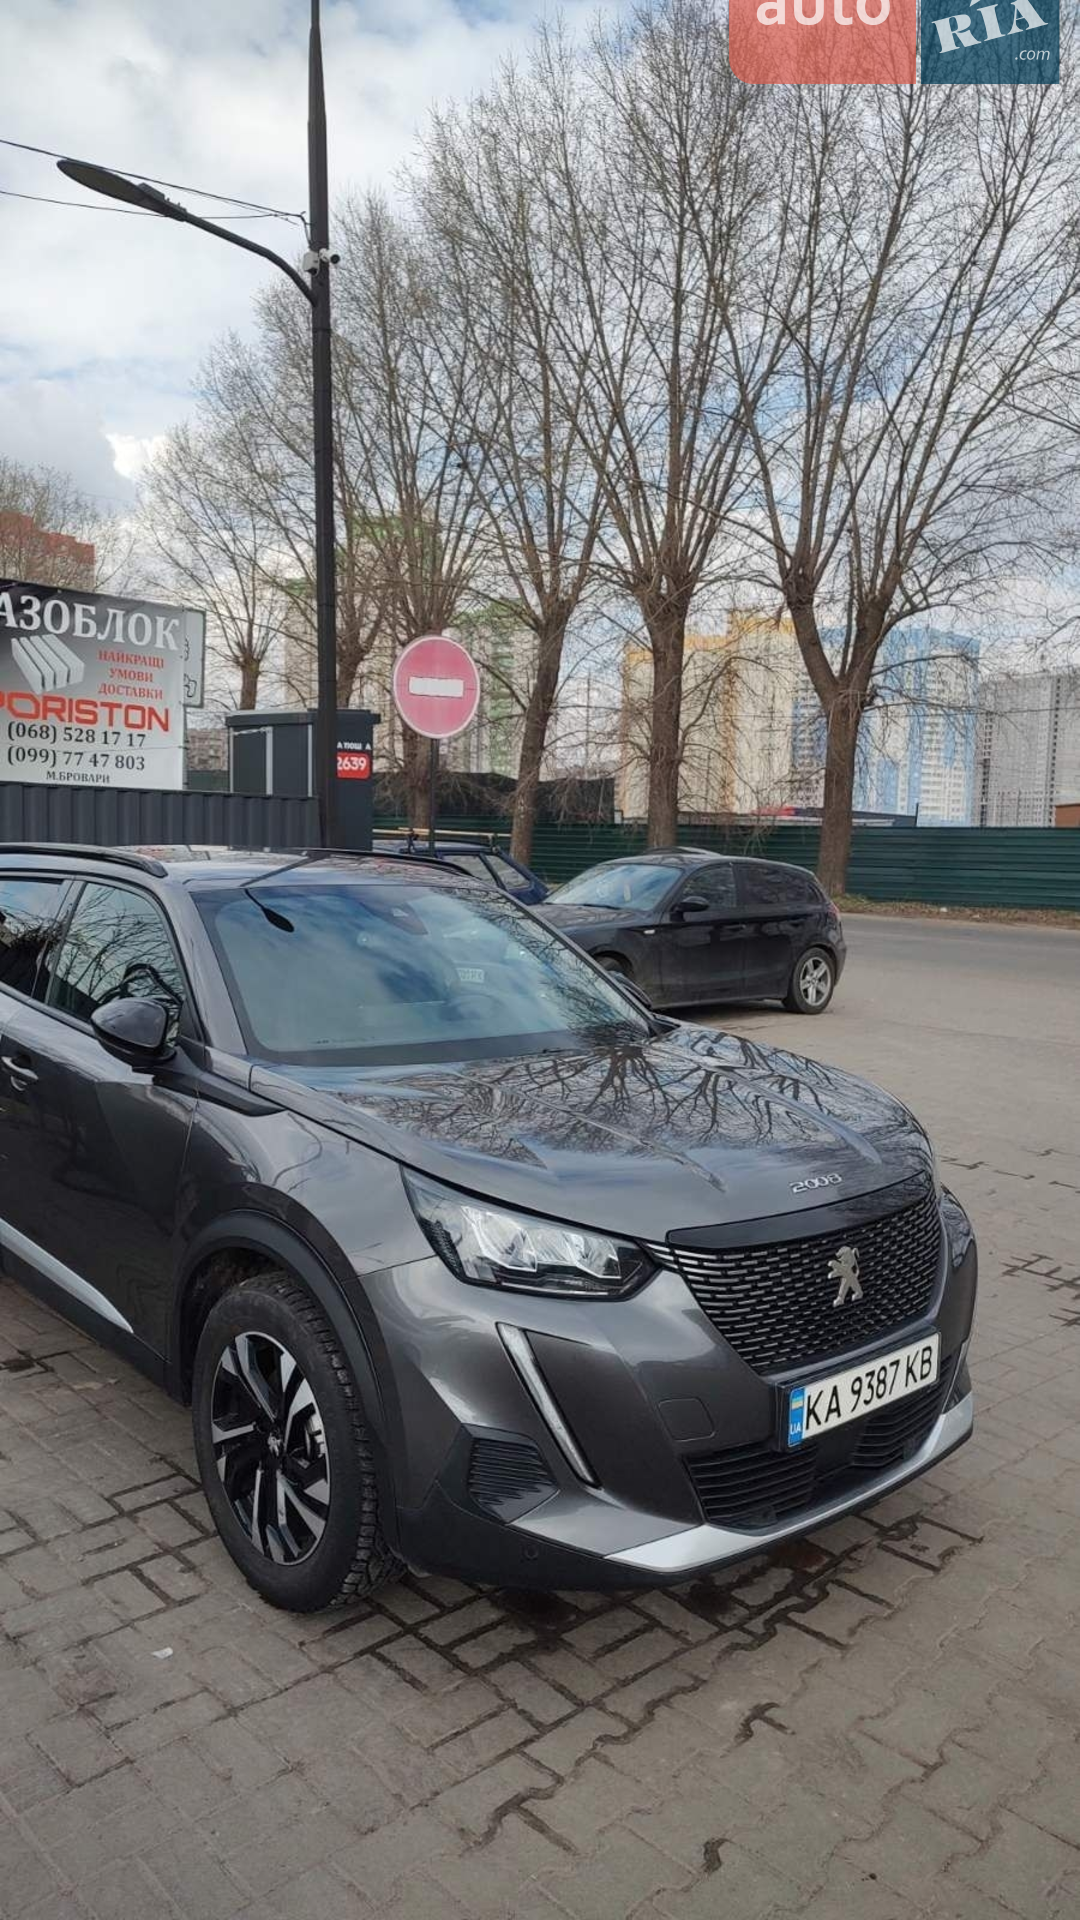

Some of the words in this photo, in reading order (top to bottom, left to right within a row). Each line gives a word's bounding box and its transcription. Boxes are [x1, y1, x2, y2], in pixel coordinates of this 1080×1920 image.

[0, 591, 179, 651] АЗОБЛОК
[109, 667, 154, 682] УМОВИ
[98, 683, 163, 700] ДОСТАВКИ
[0, 690, 170, 732] ORISTON
[7, 721, 57, 744] (068)
[63, 726, 96, 744] 528
[102, 730, 121, 746] 17
[127, 733, 147, 747] 17
[7, 744, 57, 767] (099)
[64, 751, 84, 767] 77
[89, 753, 110, 768] 47
[114, 755, 146, 771] 803
[789, 1173, 842, 1193] 2008
[805, 1384, 842, 1431] KA
[850, 1359, 901, 1412] 9387
[904, 1345, 933, 1388] KB
[790, 1421, 801, 1435] UA
